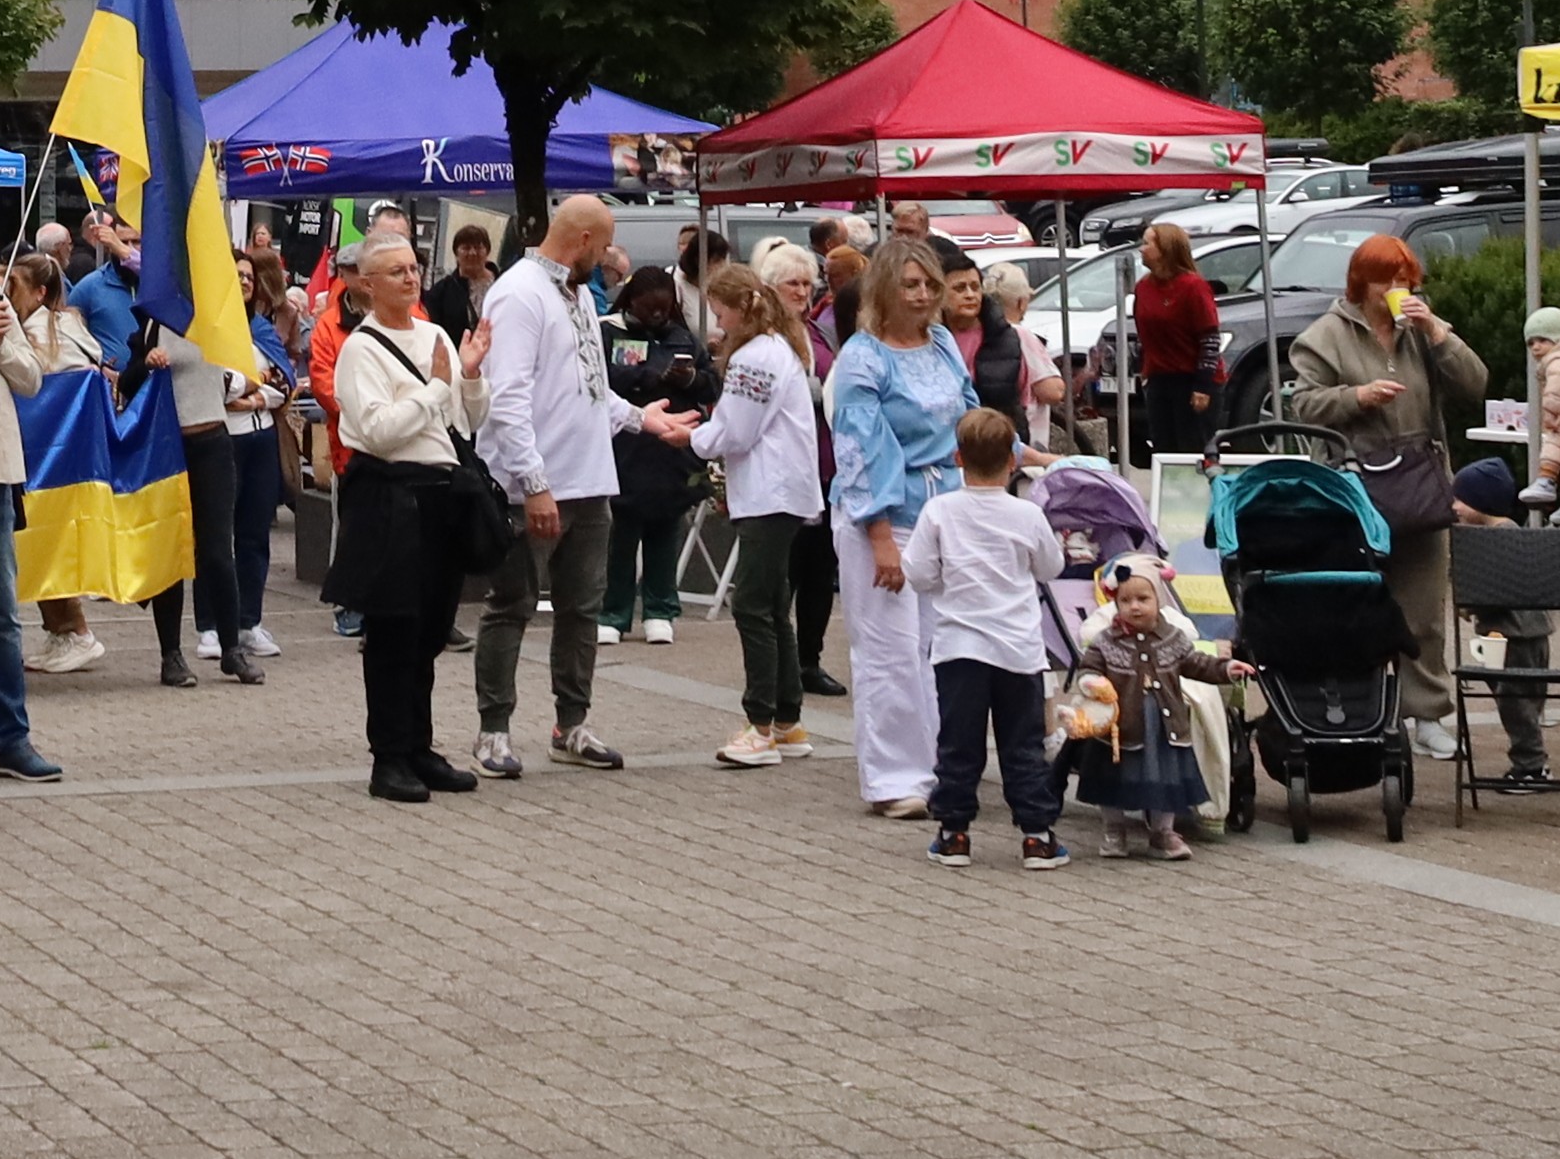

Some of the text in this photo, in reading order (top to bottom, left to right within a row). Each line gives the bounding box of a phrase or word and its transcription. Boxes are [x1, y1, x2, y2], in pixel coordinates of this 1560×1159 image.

[420, 137, 515, 184] Konserva
[895, 146, 935, 172] SV
[975, 143, 1015, 168] SV
[1053, 139, 1093, 167] SV
[1133, 141, 1169, 168] SV
[1210, 142, 1248, 168] SV
